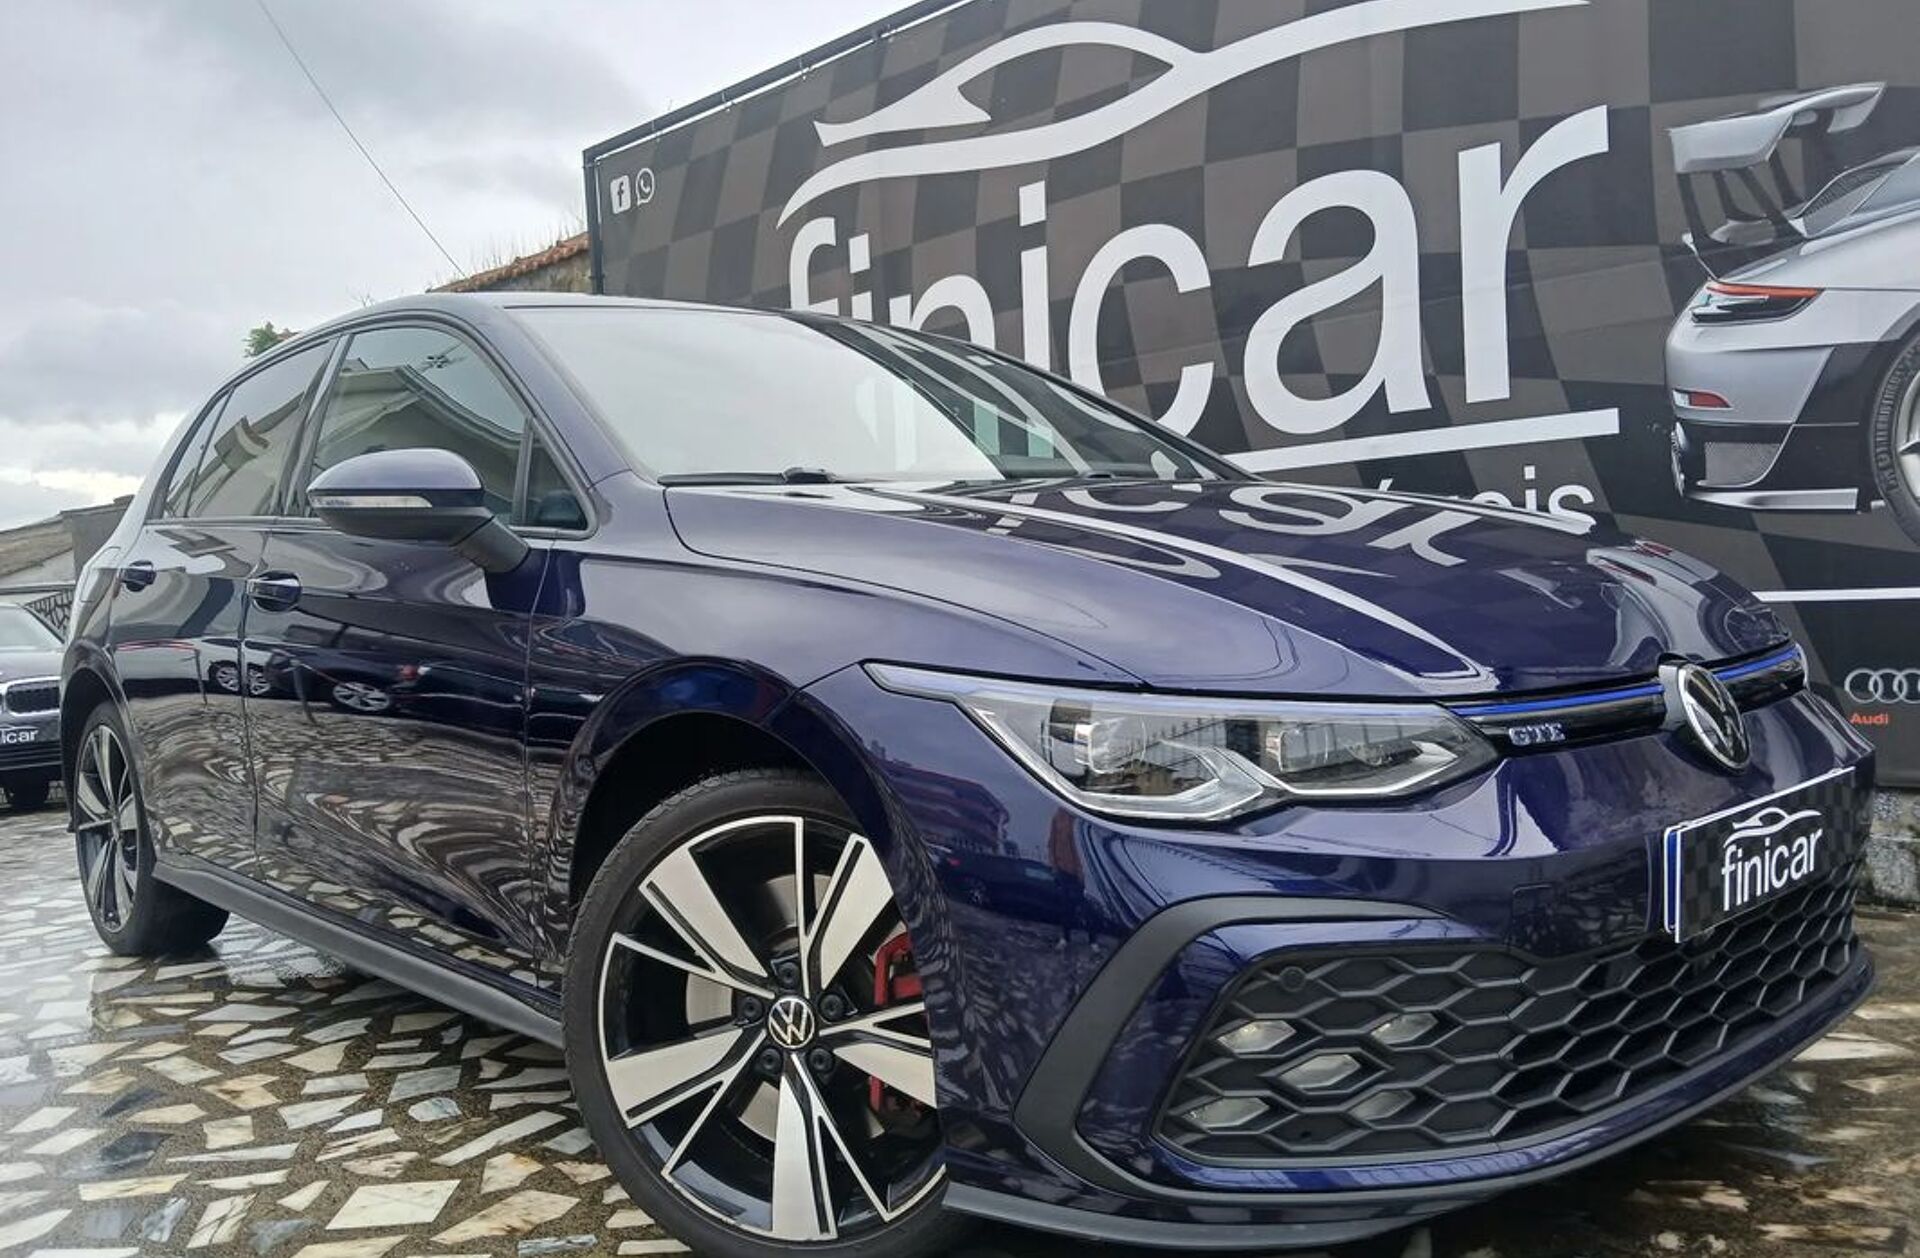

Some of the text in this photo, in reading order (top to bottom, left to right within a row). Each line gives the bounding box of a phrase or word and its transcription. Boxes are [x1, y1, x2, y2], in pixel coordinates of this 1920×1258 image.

[788, 105, 1609, 437] icar
[1850, 712, 1889, 725] Audi
[0, 730, 39, 744] icar
[1508, 723, 1566, 746] GTE
[1721, 828, 1824, 911] finicar
